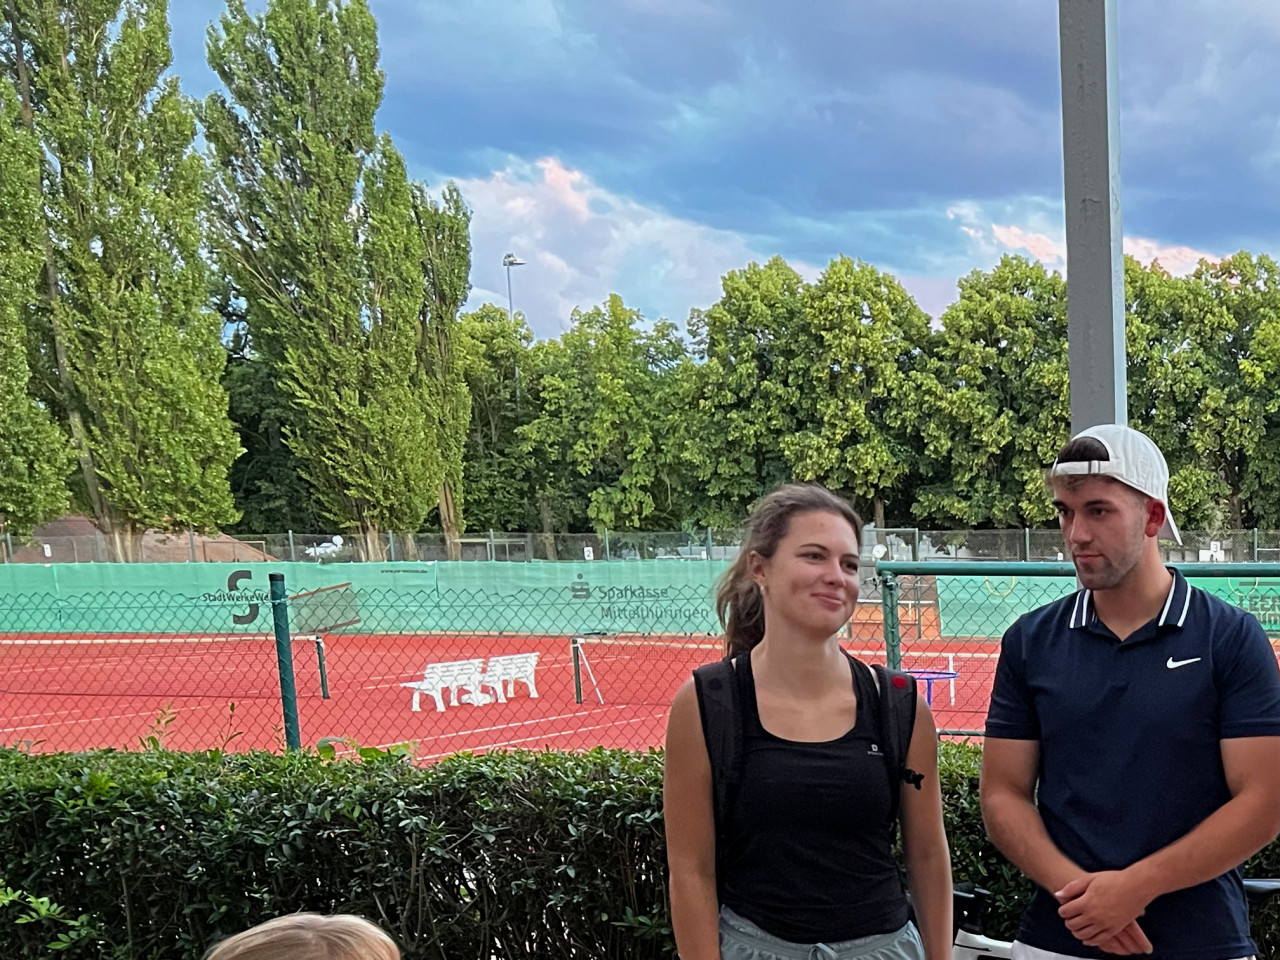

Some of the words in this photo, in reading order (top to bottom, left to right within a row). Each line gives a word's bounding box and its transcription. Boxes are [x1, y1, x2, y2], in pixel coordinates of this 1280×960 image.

[202, 592, 271, 602] StadtWerkeWe
[599, 585, 669, 601] Sparkasse
[601, 604, 709, 621] Mittelthüringen
